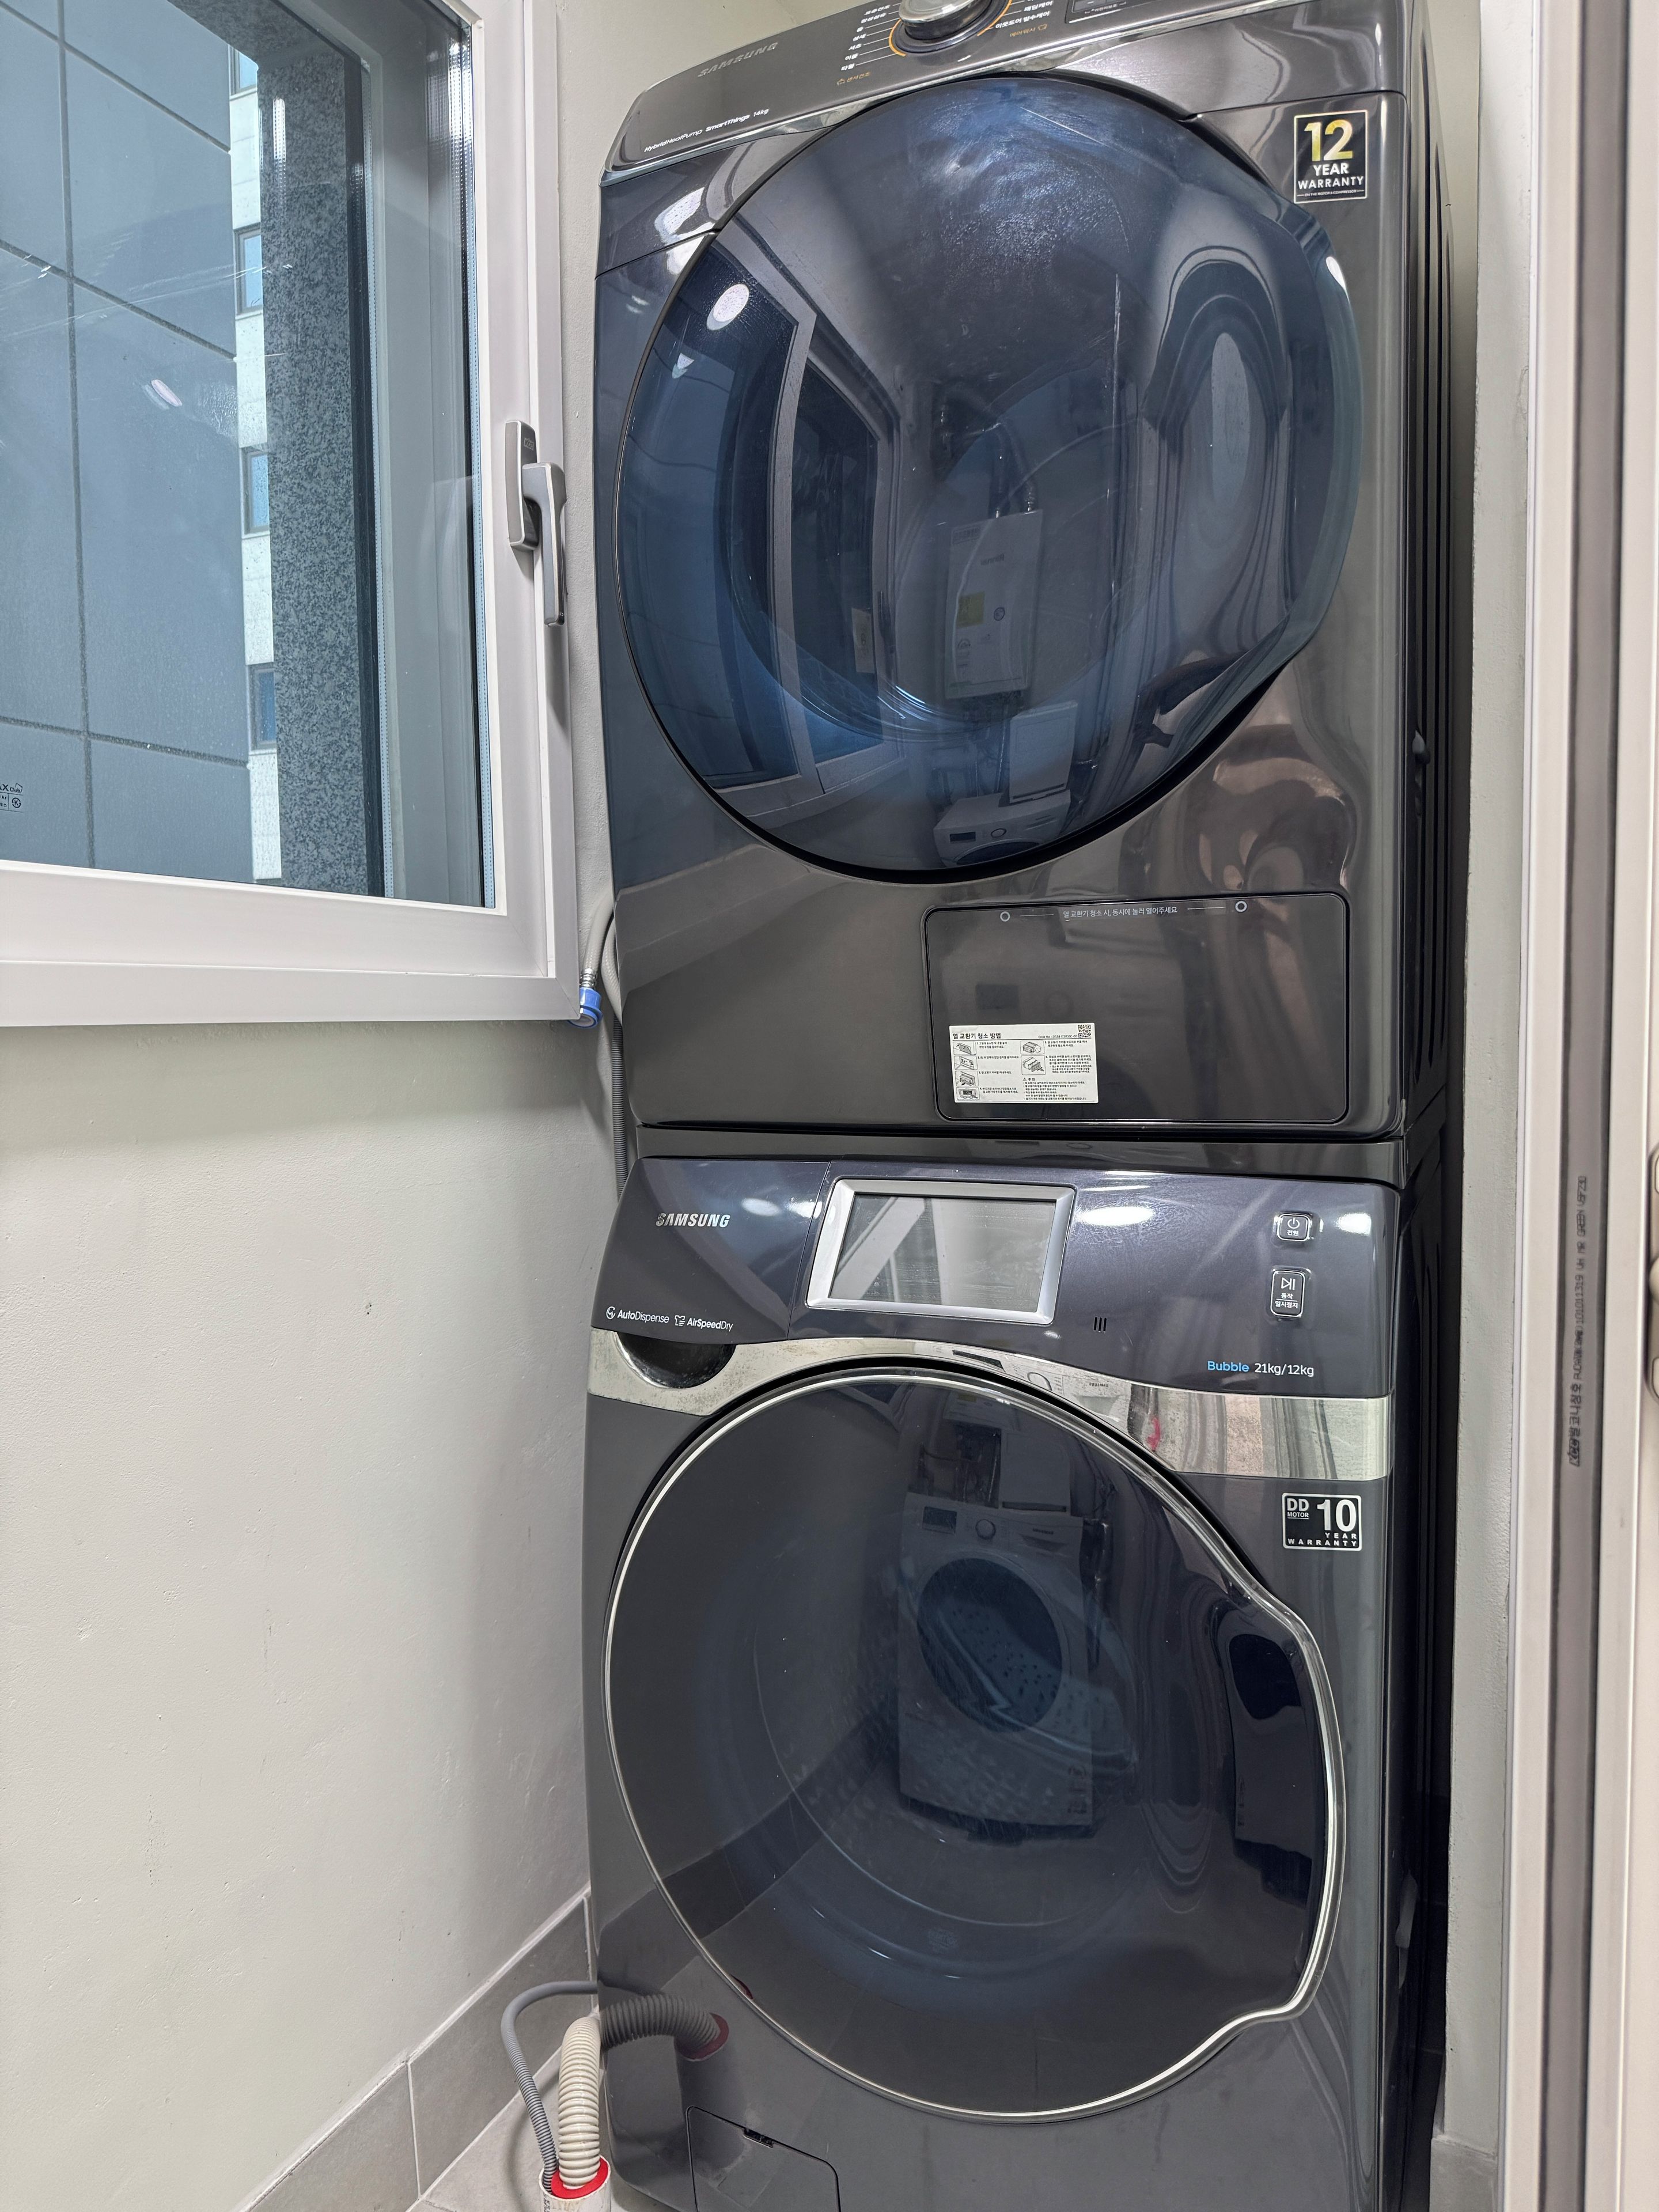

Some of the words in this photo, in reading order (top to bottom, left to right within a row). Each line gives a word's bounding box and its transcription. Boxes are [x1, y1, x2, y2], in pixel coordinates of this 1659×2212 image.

[995, 17, 1022, 28] 아웃도어
[698, 41, 778, 77] SAMSUNG
[644, 129, 703, 153] HybridHeatPump
[705, 114, 750, 132] SmartThings
[753, 108, 770, 117] 14kg
[1304, 119, 1353, 161] 12
[1313, 162, 1349, 176] YEAR
[1298, 176, 1364, 190] WARRANTY
[1146, 907, 1177, 915] 열어주세요
[656, 1213, 730, 1228] SAMSUNG
[1275, 1301, 1298, 1309] 일시정지
[617, 1309, 669, 1323] AutoDispense
[687, 1317, 733, 1332] AirSpeedDry
[1207, 1361, 1249, 1372] Bubble
[1254, 1363, 1314, 1377] 21kg/12kg
[1287, 1498, 1309, 1511] DD
[1317, 1499, 1357, 1532] 10
[1287, 1538, 1357, 1547] WARRANTY
